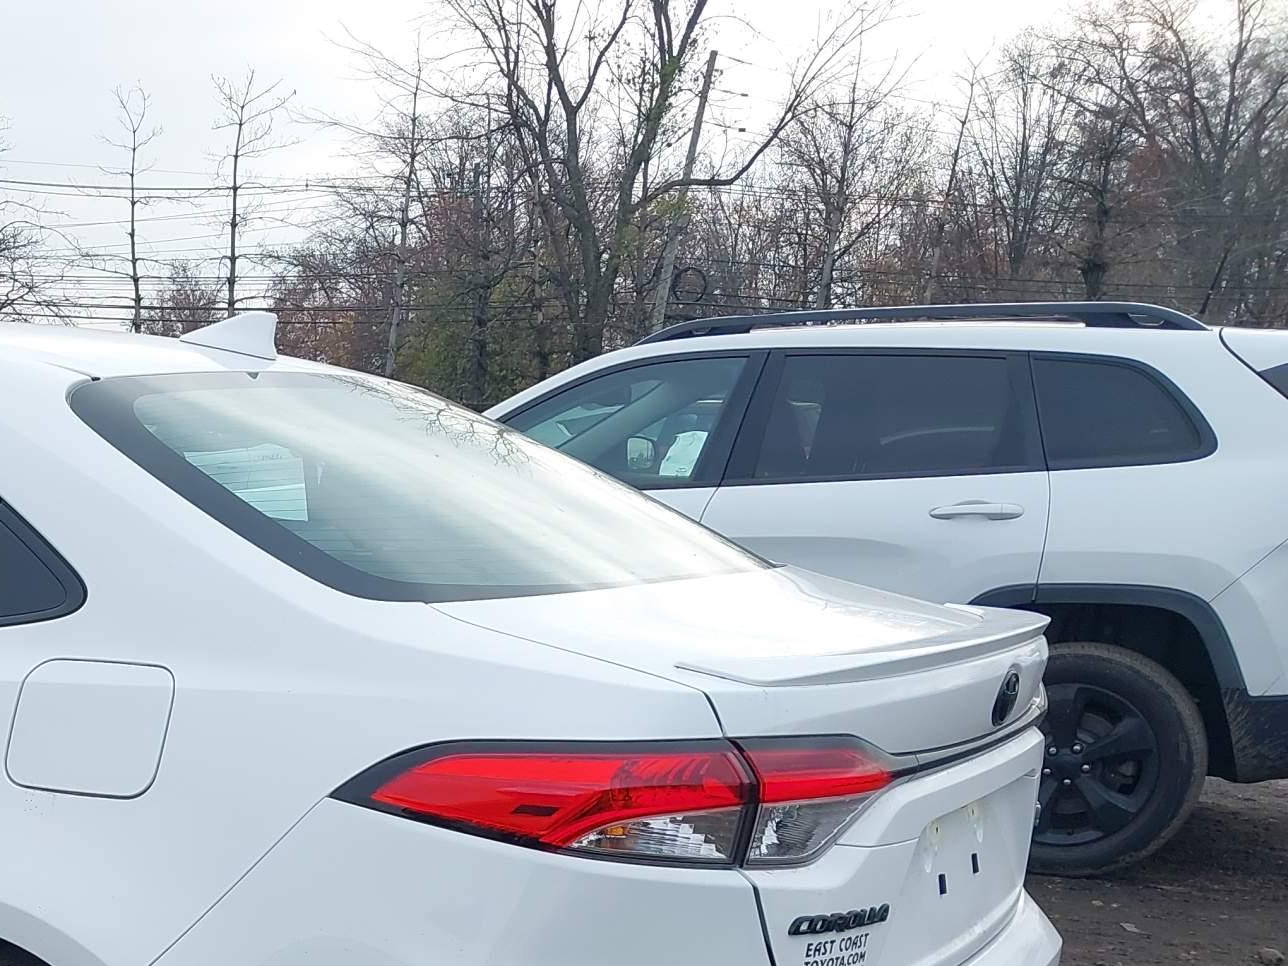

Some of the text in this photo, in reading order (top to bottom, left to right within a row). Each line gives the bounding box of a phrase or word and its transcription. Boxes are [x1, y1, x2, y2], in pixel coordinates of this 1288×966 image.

[787, 903, 890, 935] COROLLA
[805, 933, 870, 958] EAST COAST
